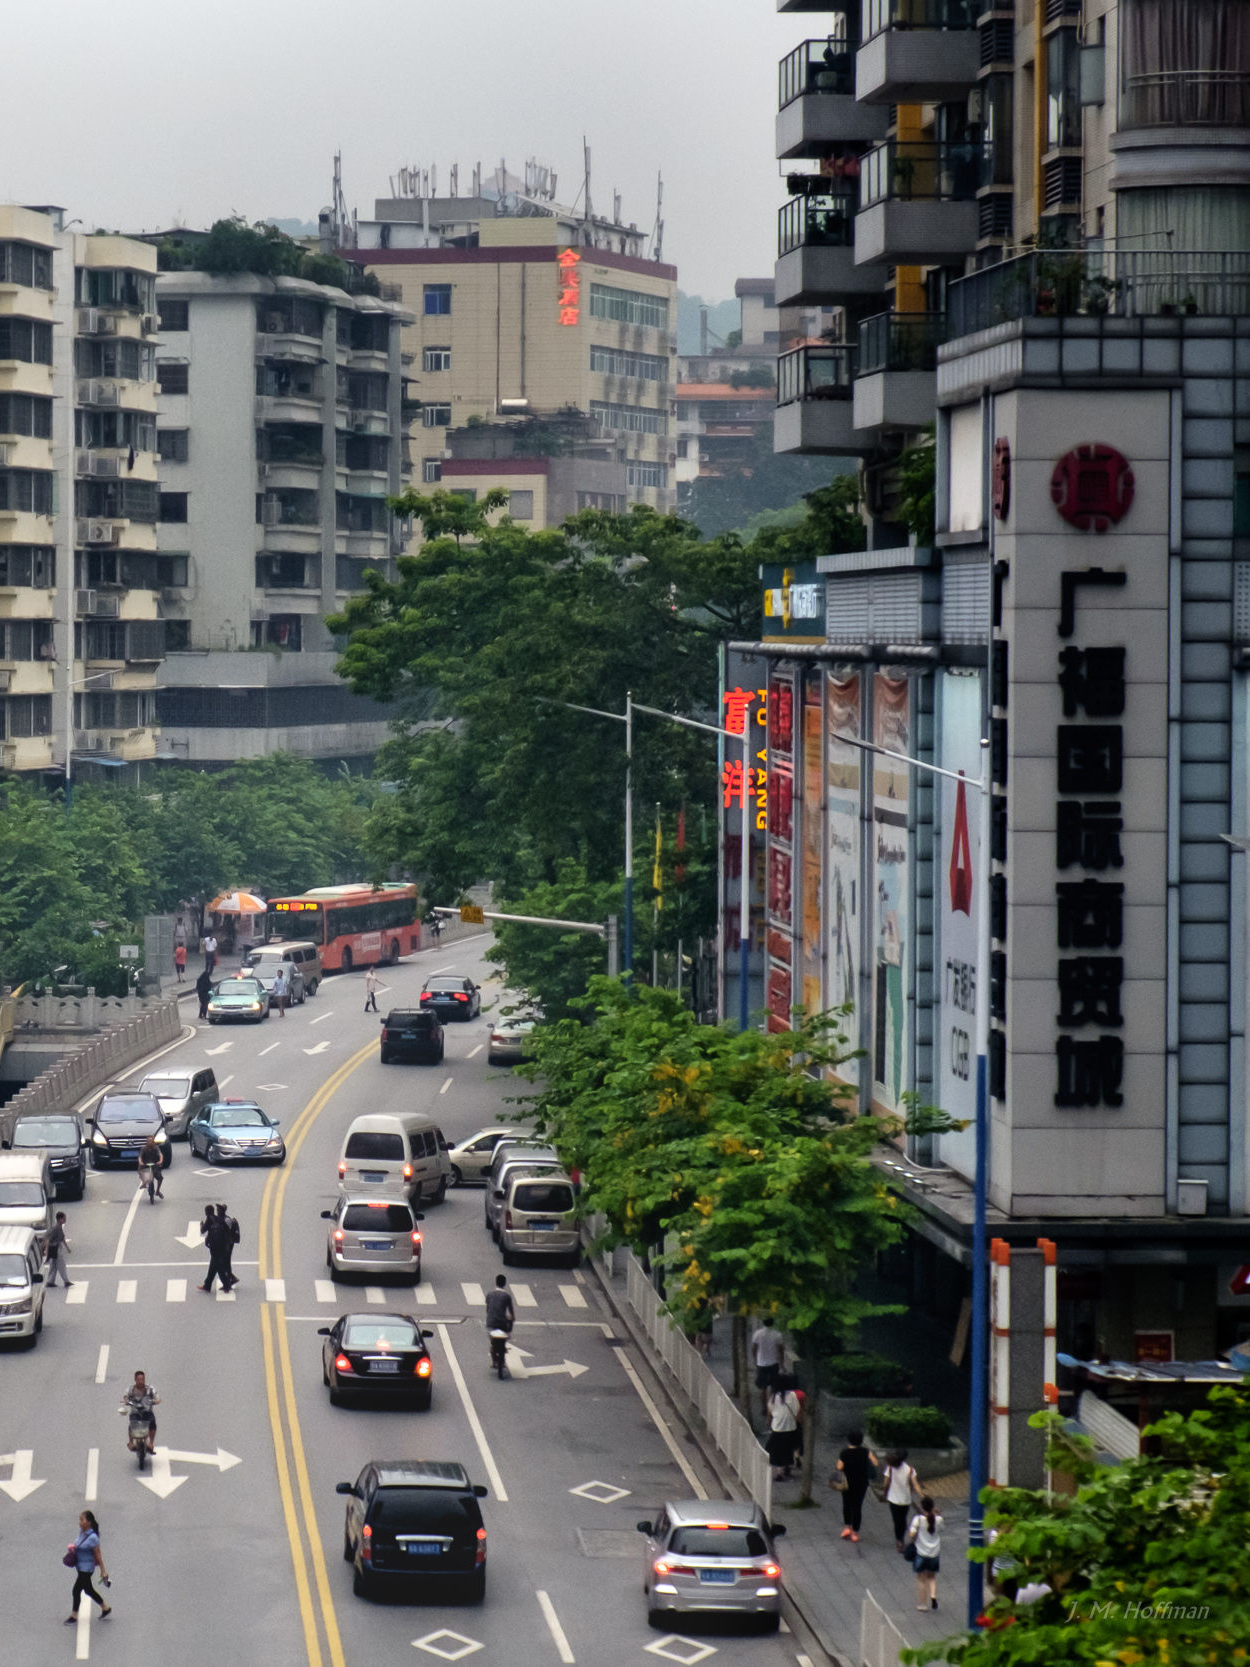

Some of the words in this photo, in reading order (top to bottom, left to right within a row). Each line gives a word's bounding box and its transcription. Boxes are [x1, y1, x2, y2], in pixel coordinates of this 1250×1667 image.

[1055, 567, 1127, 1107] 广福国际商贸城
